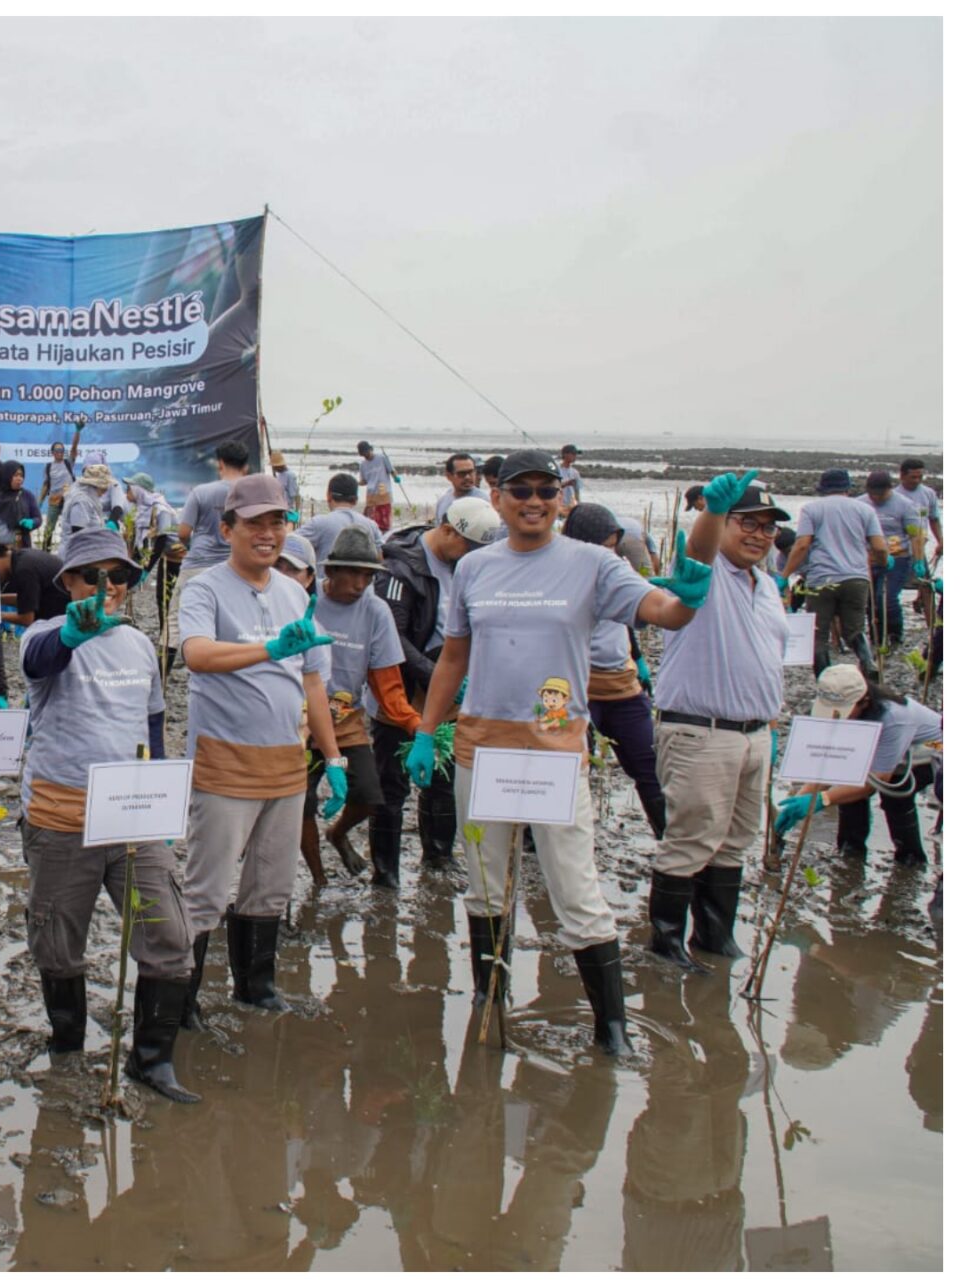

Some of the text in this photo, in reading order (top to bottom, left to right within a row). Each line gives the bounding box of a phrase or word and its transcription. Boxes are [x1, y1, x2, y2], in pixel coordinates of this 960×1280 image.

[37, 343, 124, 366] Hijaukan
[132, 338, 196, 360] Pesisir
[18, 385, 64, 400] 1.000
[69, 385, 122, 400] Pohon
[127, 380, 206, 399] Mangrove
[96, 411, 155, 422] Pasuruan,
[158, 408, 188, 420] Jawa
[191, 402, 223, 414] Timur
[14, 449, 24, 457] 11
